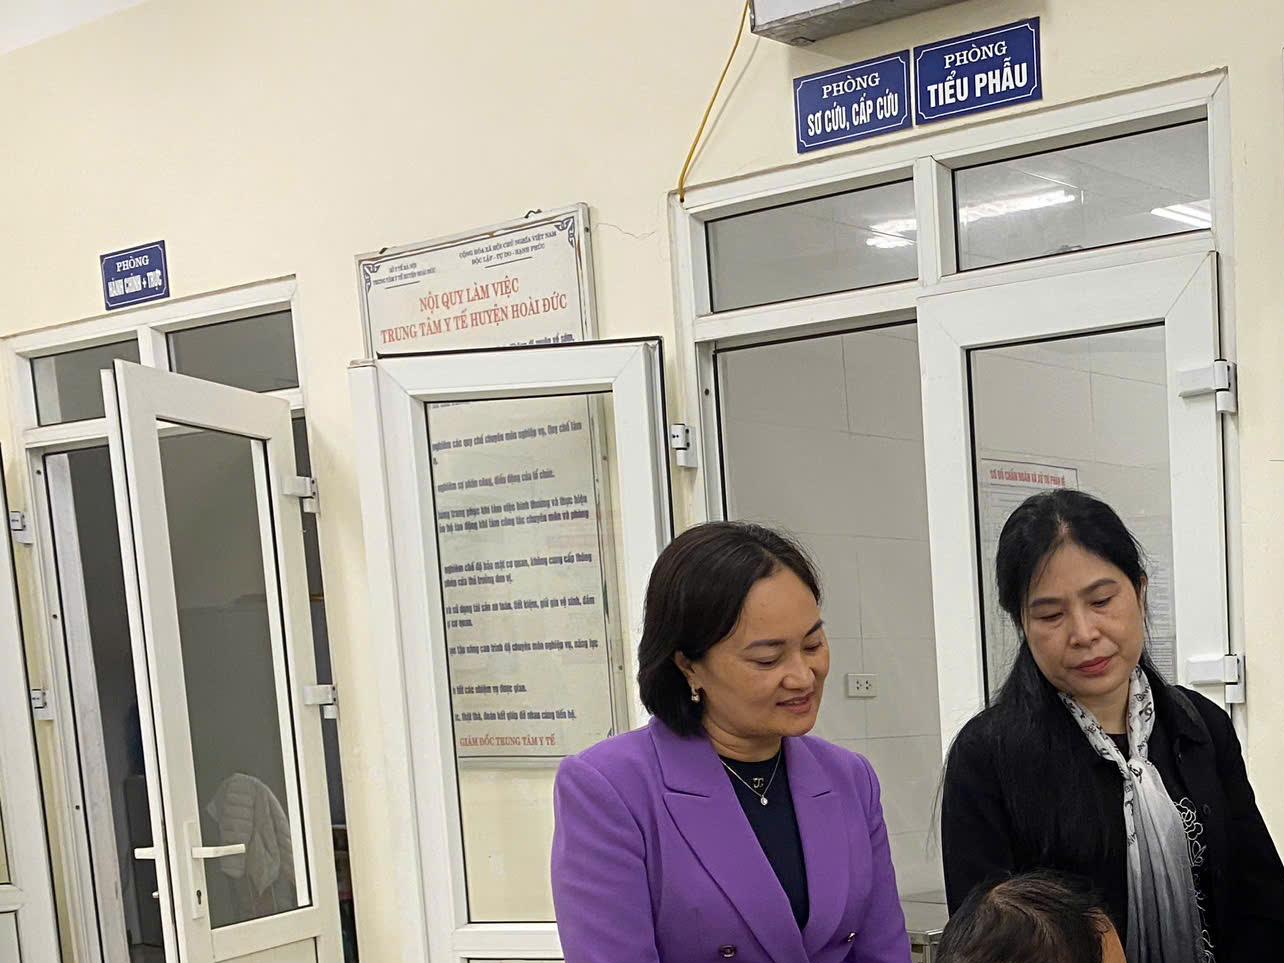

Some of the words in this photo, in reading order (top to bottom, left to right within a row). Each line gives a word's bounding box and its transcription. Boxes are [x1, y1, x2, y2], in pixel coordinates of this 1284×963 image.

[944, 41, 1008, 69] PHÒNG
[822, 72, 881, 99] PHÒNG
[927, 70, 969, 108] TIỂU
[975, 57, 1028, 98] PHẪU
[807, 114, 822, 137] SƠ
[825, 101, 850, 133] CỨU,
[852, 93, 872, 126] CẤP
[876, 88, 898, 120] CỨU
[116, 255, 150, 272] PHÒNG
[418, 290, 440, 314] NỘI
[440, 288, 464, 310] QUY
[465, 281, 490, 303] LÀM
[490, 274, 519, 298] VIỆC
[380, 323, 417, 344] TRUNG
[418, 312, 442, 336] TÂM
[443, 316, 451, 332] Y
[452, 307, 468, 330] TẾ
[469, 303, 508, 328] HUYỆN
[510, 295, 540, 319] HOÀI
[541, 290, 567, 313] ĐỨC
